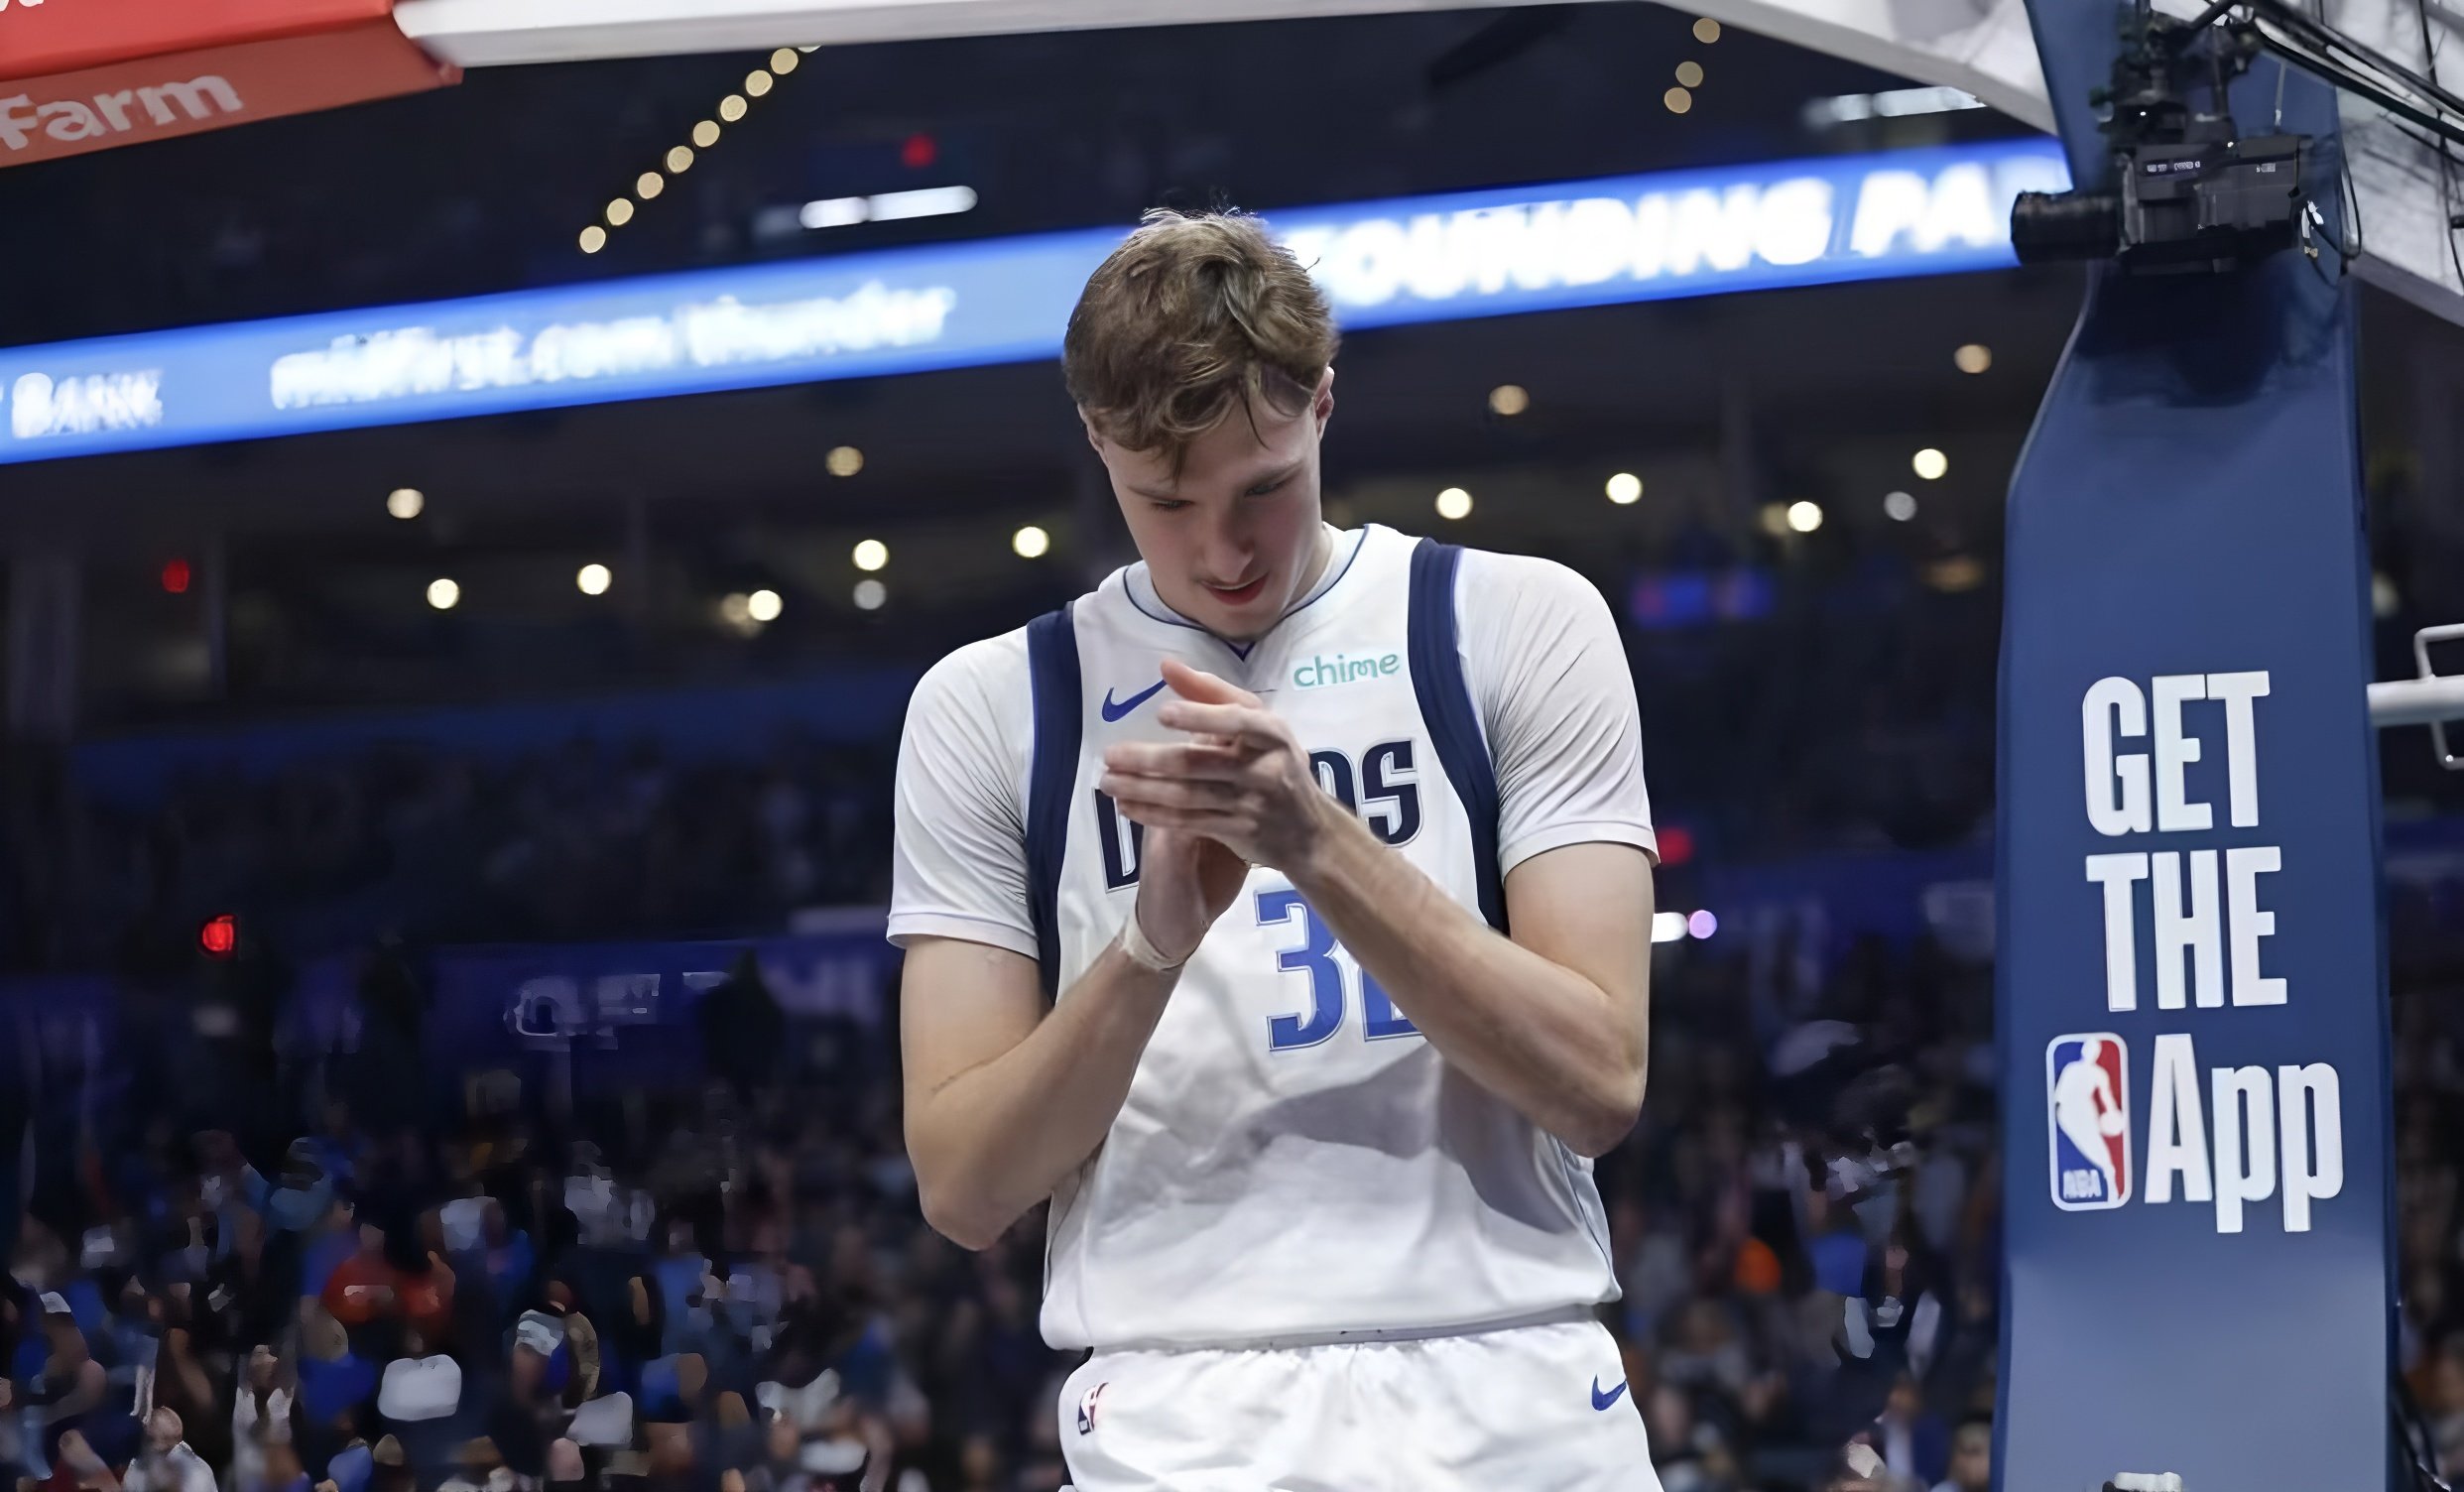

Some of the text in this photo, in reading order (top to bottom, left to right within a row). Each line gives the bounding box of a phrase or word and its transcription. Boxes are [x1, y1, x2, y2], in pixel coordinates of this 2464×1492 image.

[0, 75, 244, 150] Farm
[1294, 654, 1400, 686] chime
[2082, 671, 2271, 836] GET
[2085, 846, 2287, 1012] THE
[2145, 1033, 2343, 1233] App
